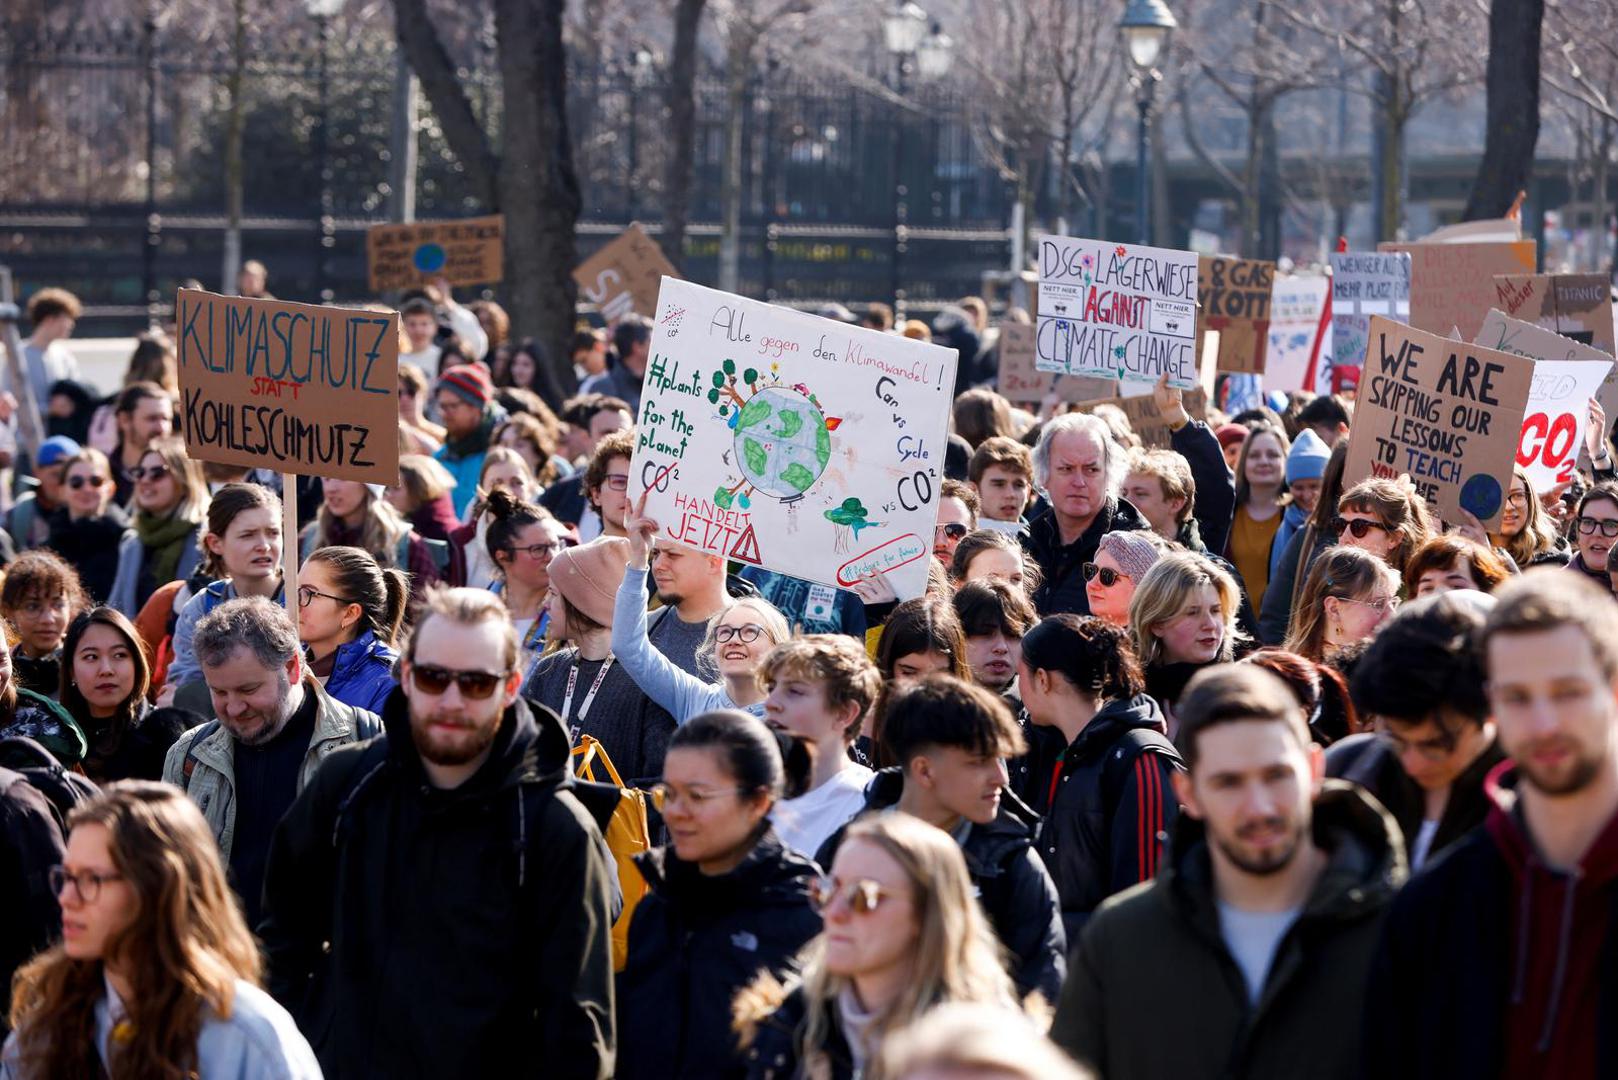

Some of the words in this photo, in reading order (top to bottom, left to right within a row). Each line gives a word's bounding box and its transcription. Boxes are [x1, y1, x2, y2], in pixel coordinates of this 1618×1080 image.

[1043, 241, 1083, 279] DSG
[1095, 250, 1197, 300] LAGERWIESE
[1211, 259, 1226, 288] &
[1229, 262, 1271, 288] GAS
[1507, 280, 1536, 315] dieser
[1556, 286, 1604, 301] TITANIC
[181, 299, 391, 395] KLIMASCHUTZ
[710, 306, 752, 342] Alle
[758, 335, 800, 358] gegen
[812, 335, 838, 361] den
[1037, 318, 1121, 371] CLIMATE
[1124, 335, 1193, 381] CHANGE
[250, 377, 305, 400] STATT
[648, 353, 703, 398] #plants
[1379, 332, 1424, 385] WE
[1435, 353, 1505, 407] ARE
[185, 388, 375, 467] KOHLESCHMUTZ
[643, 400, 666, 426] for
[671, 409, 694, 437] the
[892, 413, 907, 429] vs
[1368, 375, 1443, 424] SKIPPING
[1451, 405, 1492, 436] OUR
[637, 428, 688, 459] planet
[897, 435, 929, 463] Cycle
[1389, 415, 1468, 459] LESSONS
[1375, 436, 1397, 465] TO
[1405, 447, 1463, 486] TEACH
[674, 491, 752, 530] HANDELT
[667, 512, 740, 556] JETZT
